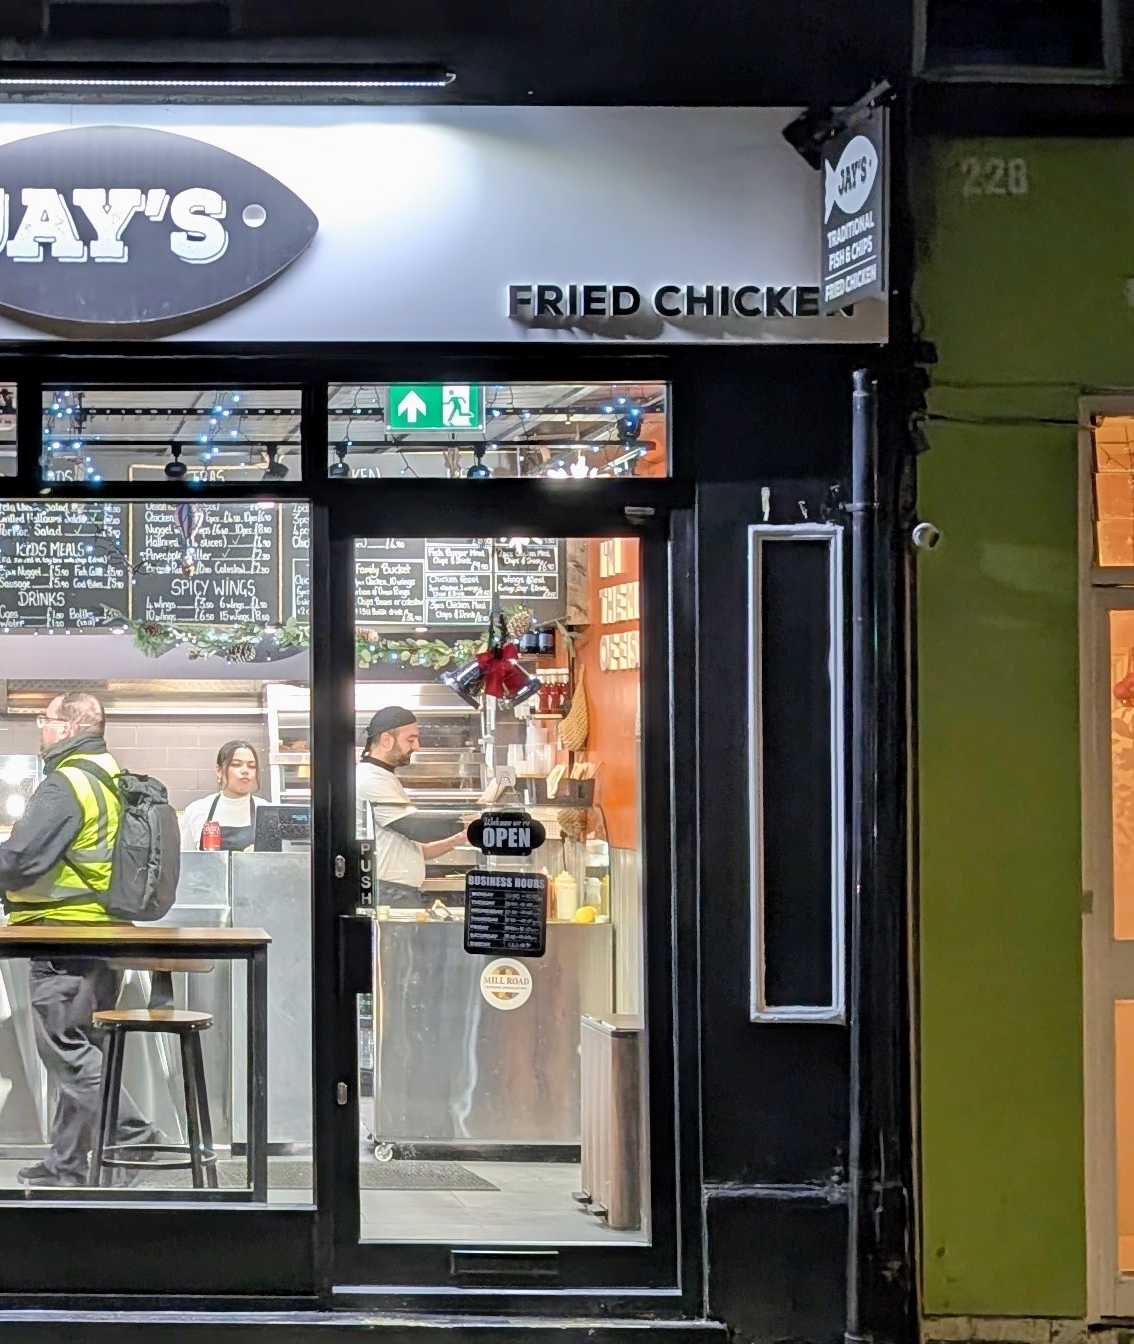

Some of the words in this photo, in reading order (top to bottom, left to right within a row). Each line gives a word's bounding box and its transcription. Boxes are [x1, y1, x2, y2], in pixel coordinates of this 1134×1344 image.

[838, 156, 867, 196] JAY'S
[961, 158, 1027, 195] 228
[827, 211, 875, 248] TRADITIONAL
[828, 247, 845, 271] FISH
[851, 235, 873, 259] CHIPS
[824, 275, 846, 302] FRIED
[845, 264, 877, 293] CHICKEN
[506, 285, 642, 317] FRIED
[653, 285, 856, 317] CHICKE
[145, 511, 176, 523] Chicken
[34, 524, 62, 537] Salad
[145, 523, 173, 538] Nugget
[50, 541, 85, 557] MEALS
[17, 564, 42, 579] Nugget
[355, 563, 380, 579] Family
[381, 562, 412, 575] Bucket
[73, 578, 87, 588] Cod
[170, 578, 210, 596] SPICY
[213, 577, 256, 596] WINGS
[17, 591, 66, 606] DRINKS
[155, 596, 177, 611] wings
[599, 581, 640, 624] THEM
[483, 827, 531, 848] OPEN
[360, 842, 372, 905] PUSH
[468, 875, 512, 888] BUSINESS
[514, 877, 545, 889] HOURS
[483, 976, 506, 985] MILL
[506, 977, 530, 986] ROAD
